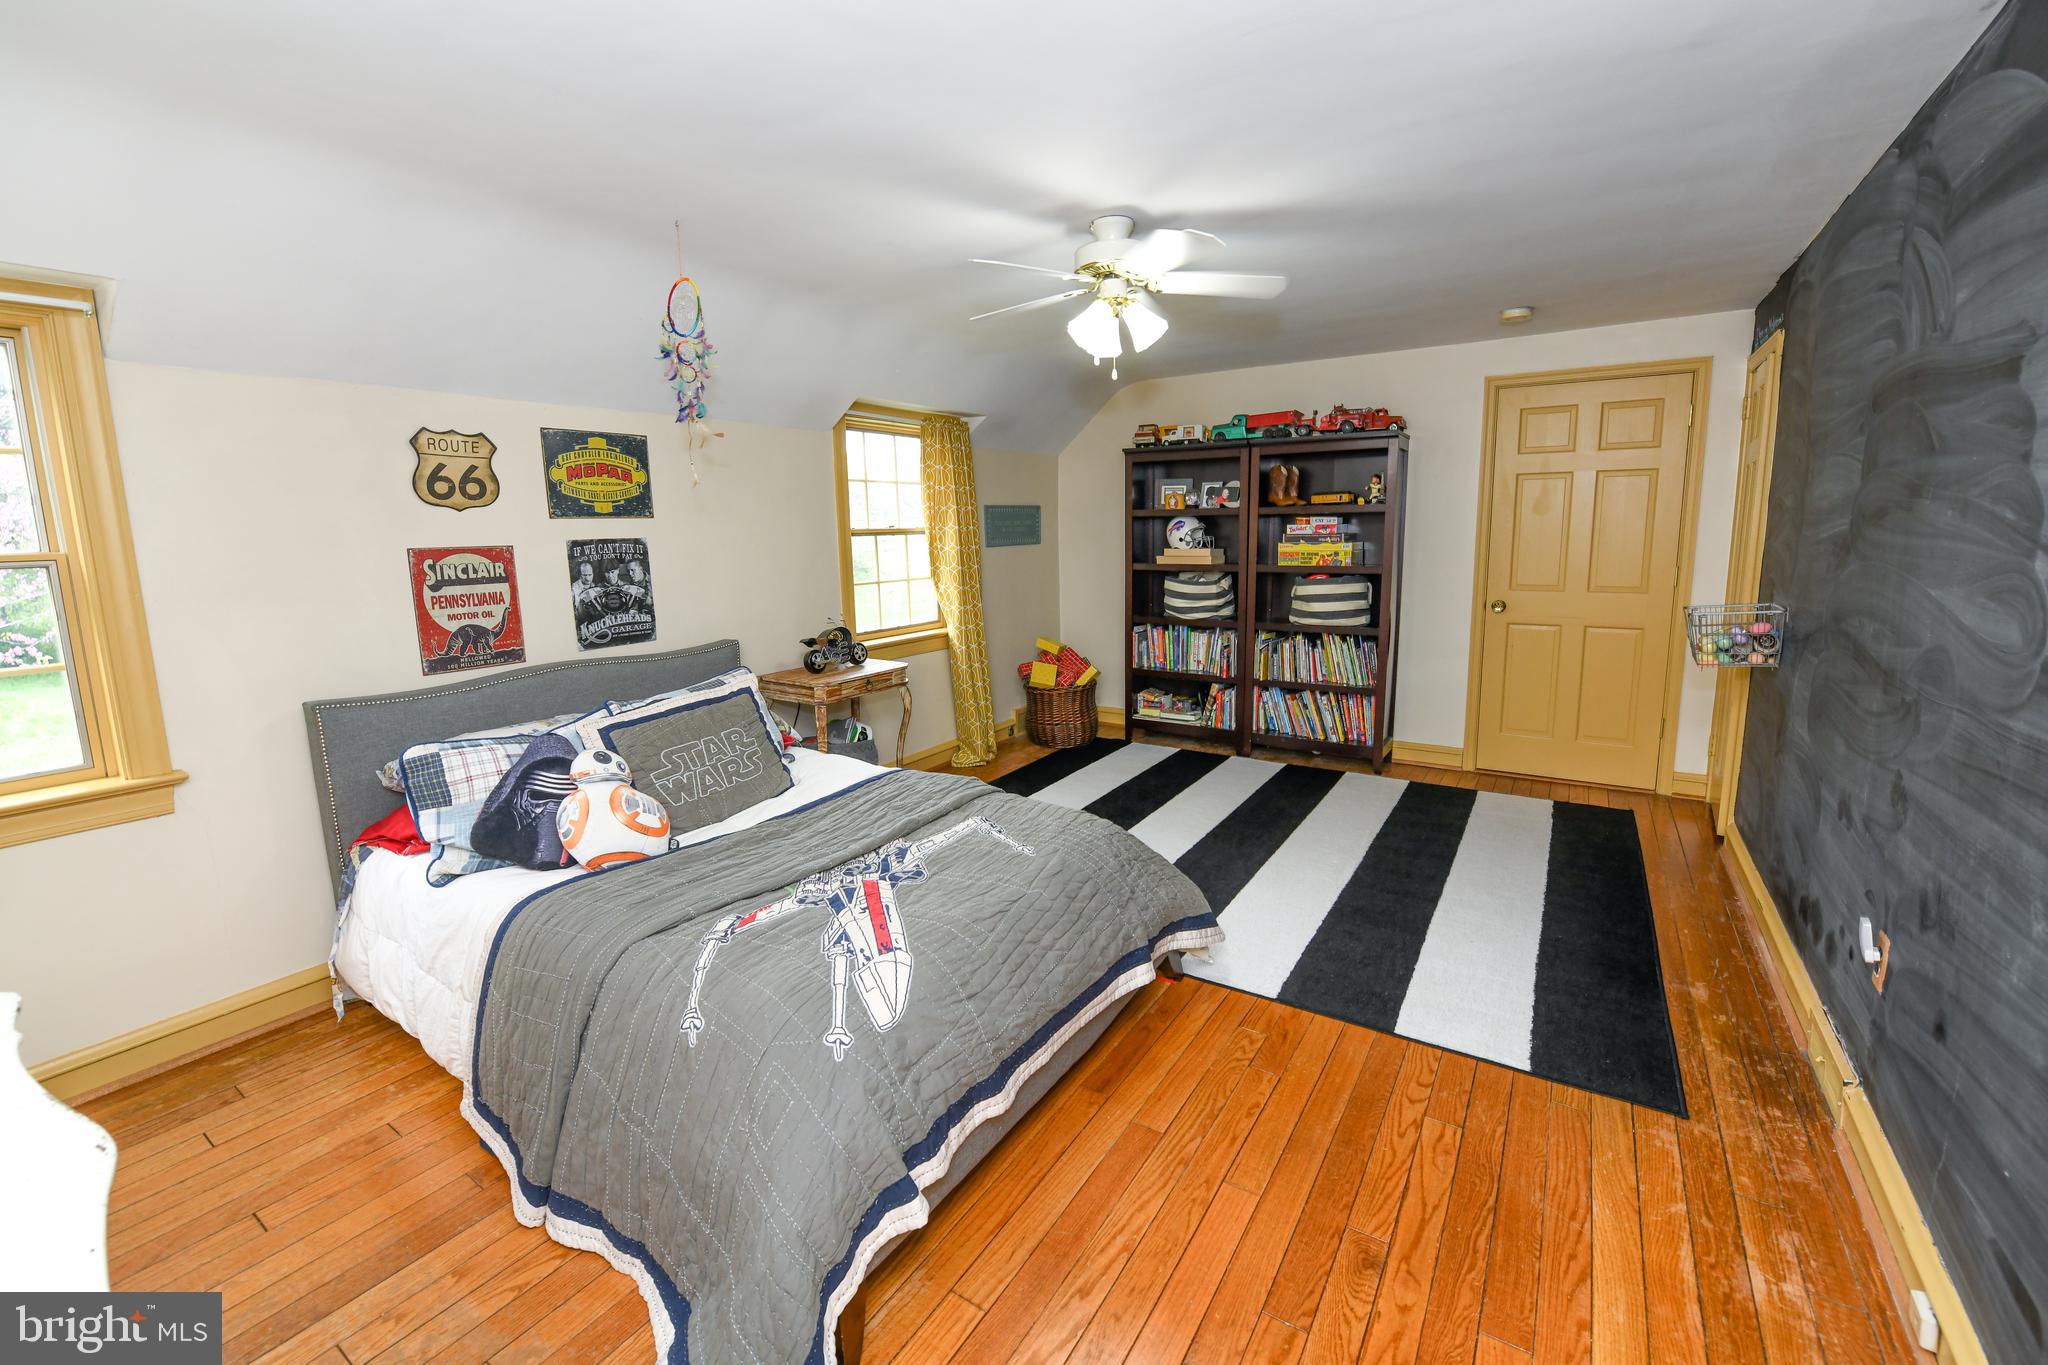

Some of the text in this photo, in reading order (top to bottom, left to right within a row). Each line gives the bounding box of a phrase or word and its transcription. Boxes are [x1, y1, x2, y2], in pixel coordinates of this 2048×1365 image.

[427, 437, 480, 454] ROUTE
[426, 462, 487, 501] 66
[565, 462, 633, 484] MOPAR
[573, 543, 644, 557] IF WE CAN'T FIX IT
[423, 558, 507, 586] SINCLAIR
[430, 591, 506, 610] PENNSYLVANIA
[447, 610, 495, 622] MOTOR OIL
[611, 622, 652, 633] GARAGE
[460, 655, 492, 663] MELLOWED
[650, 727, 758, 783] STAR
[655, 748, 763, 806] WARS
